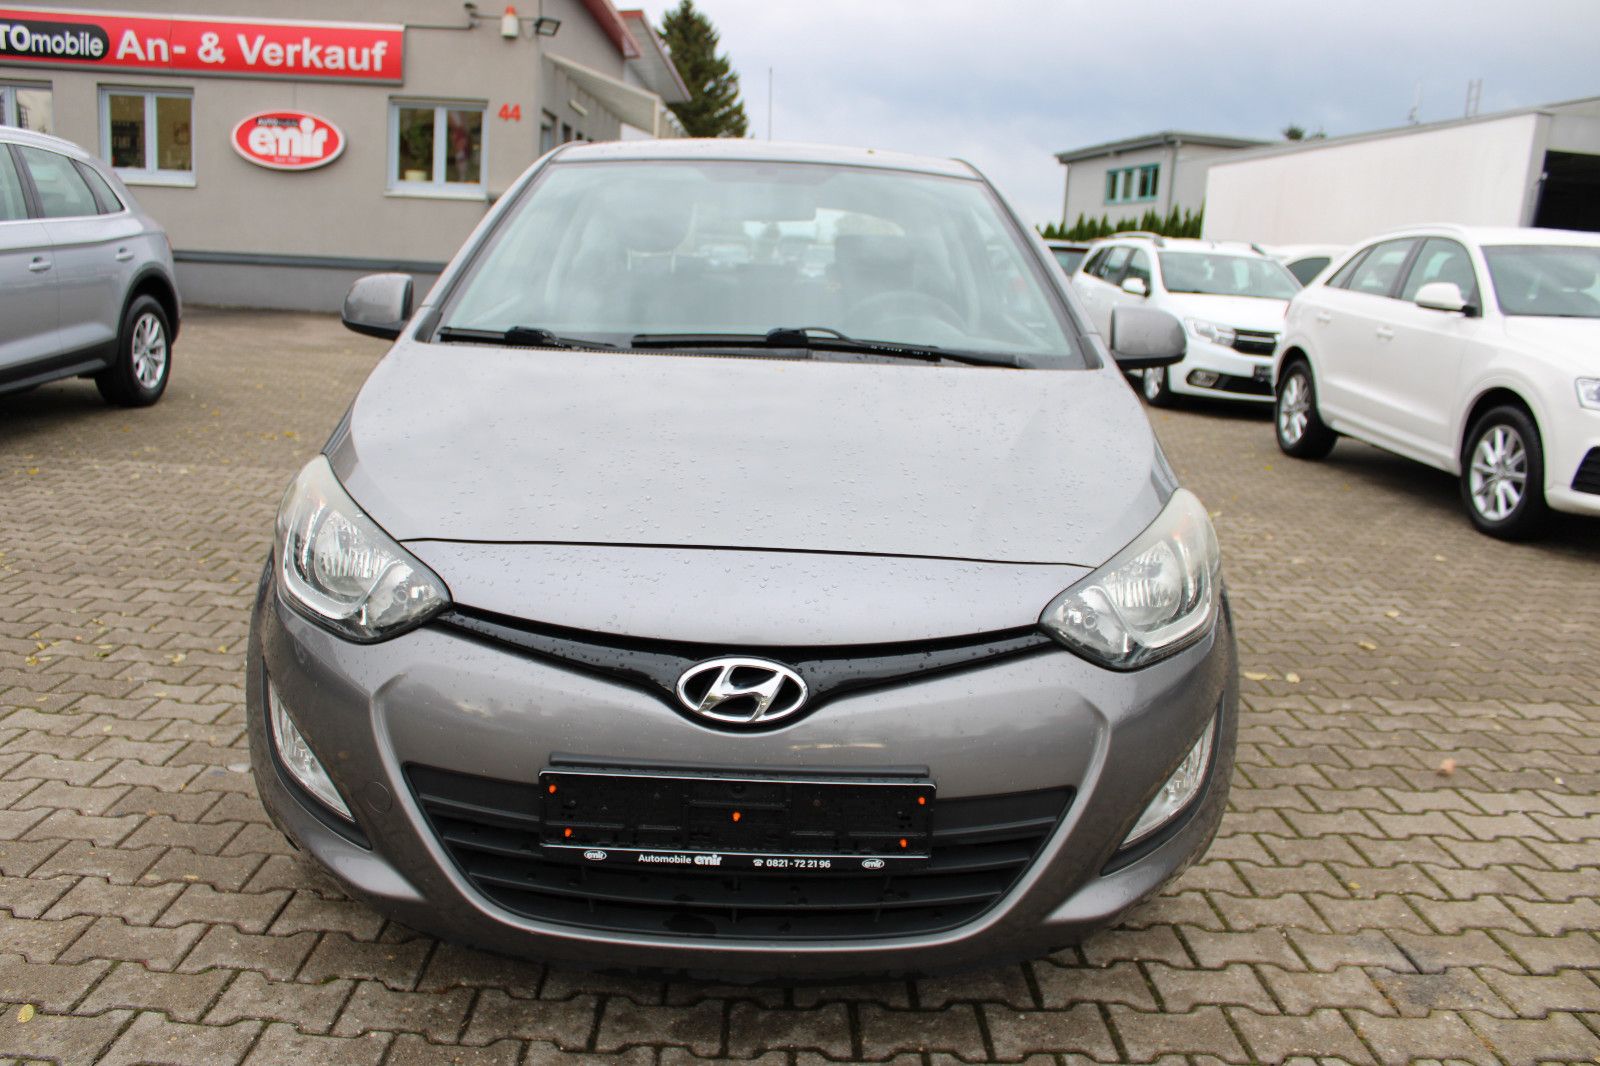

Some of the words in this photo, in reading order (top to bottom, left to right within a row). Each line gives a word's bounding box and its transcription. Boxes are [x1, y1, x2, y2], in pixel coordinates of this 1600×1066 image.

[116, 29, 186, 62] An-
[197, 31, 226, 64] &
[237, 33, 388, 71] Verkauf
[497, 103, 521, 121] 44
[248, 117, 328, 158] emir
[638, 854, 692, 864] Automobile
[694, 854, 722, 866] emir
